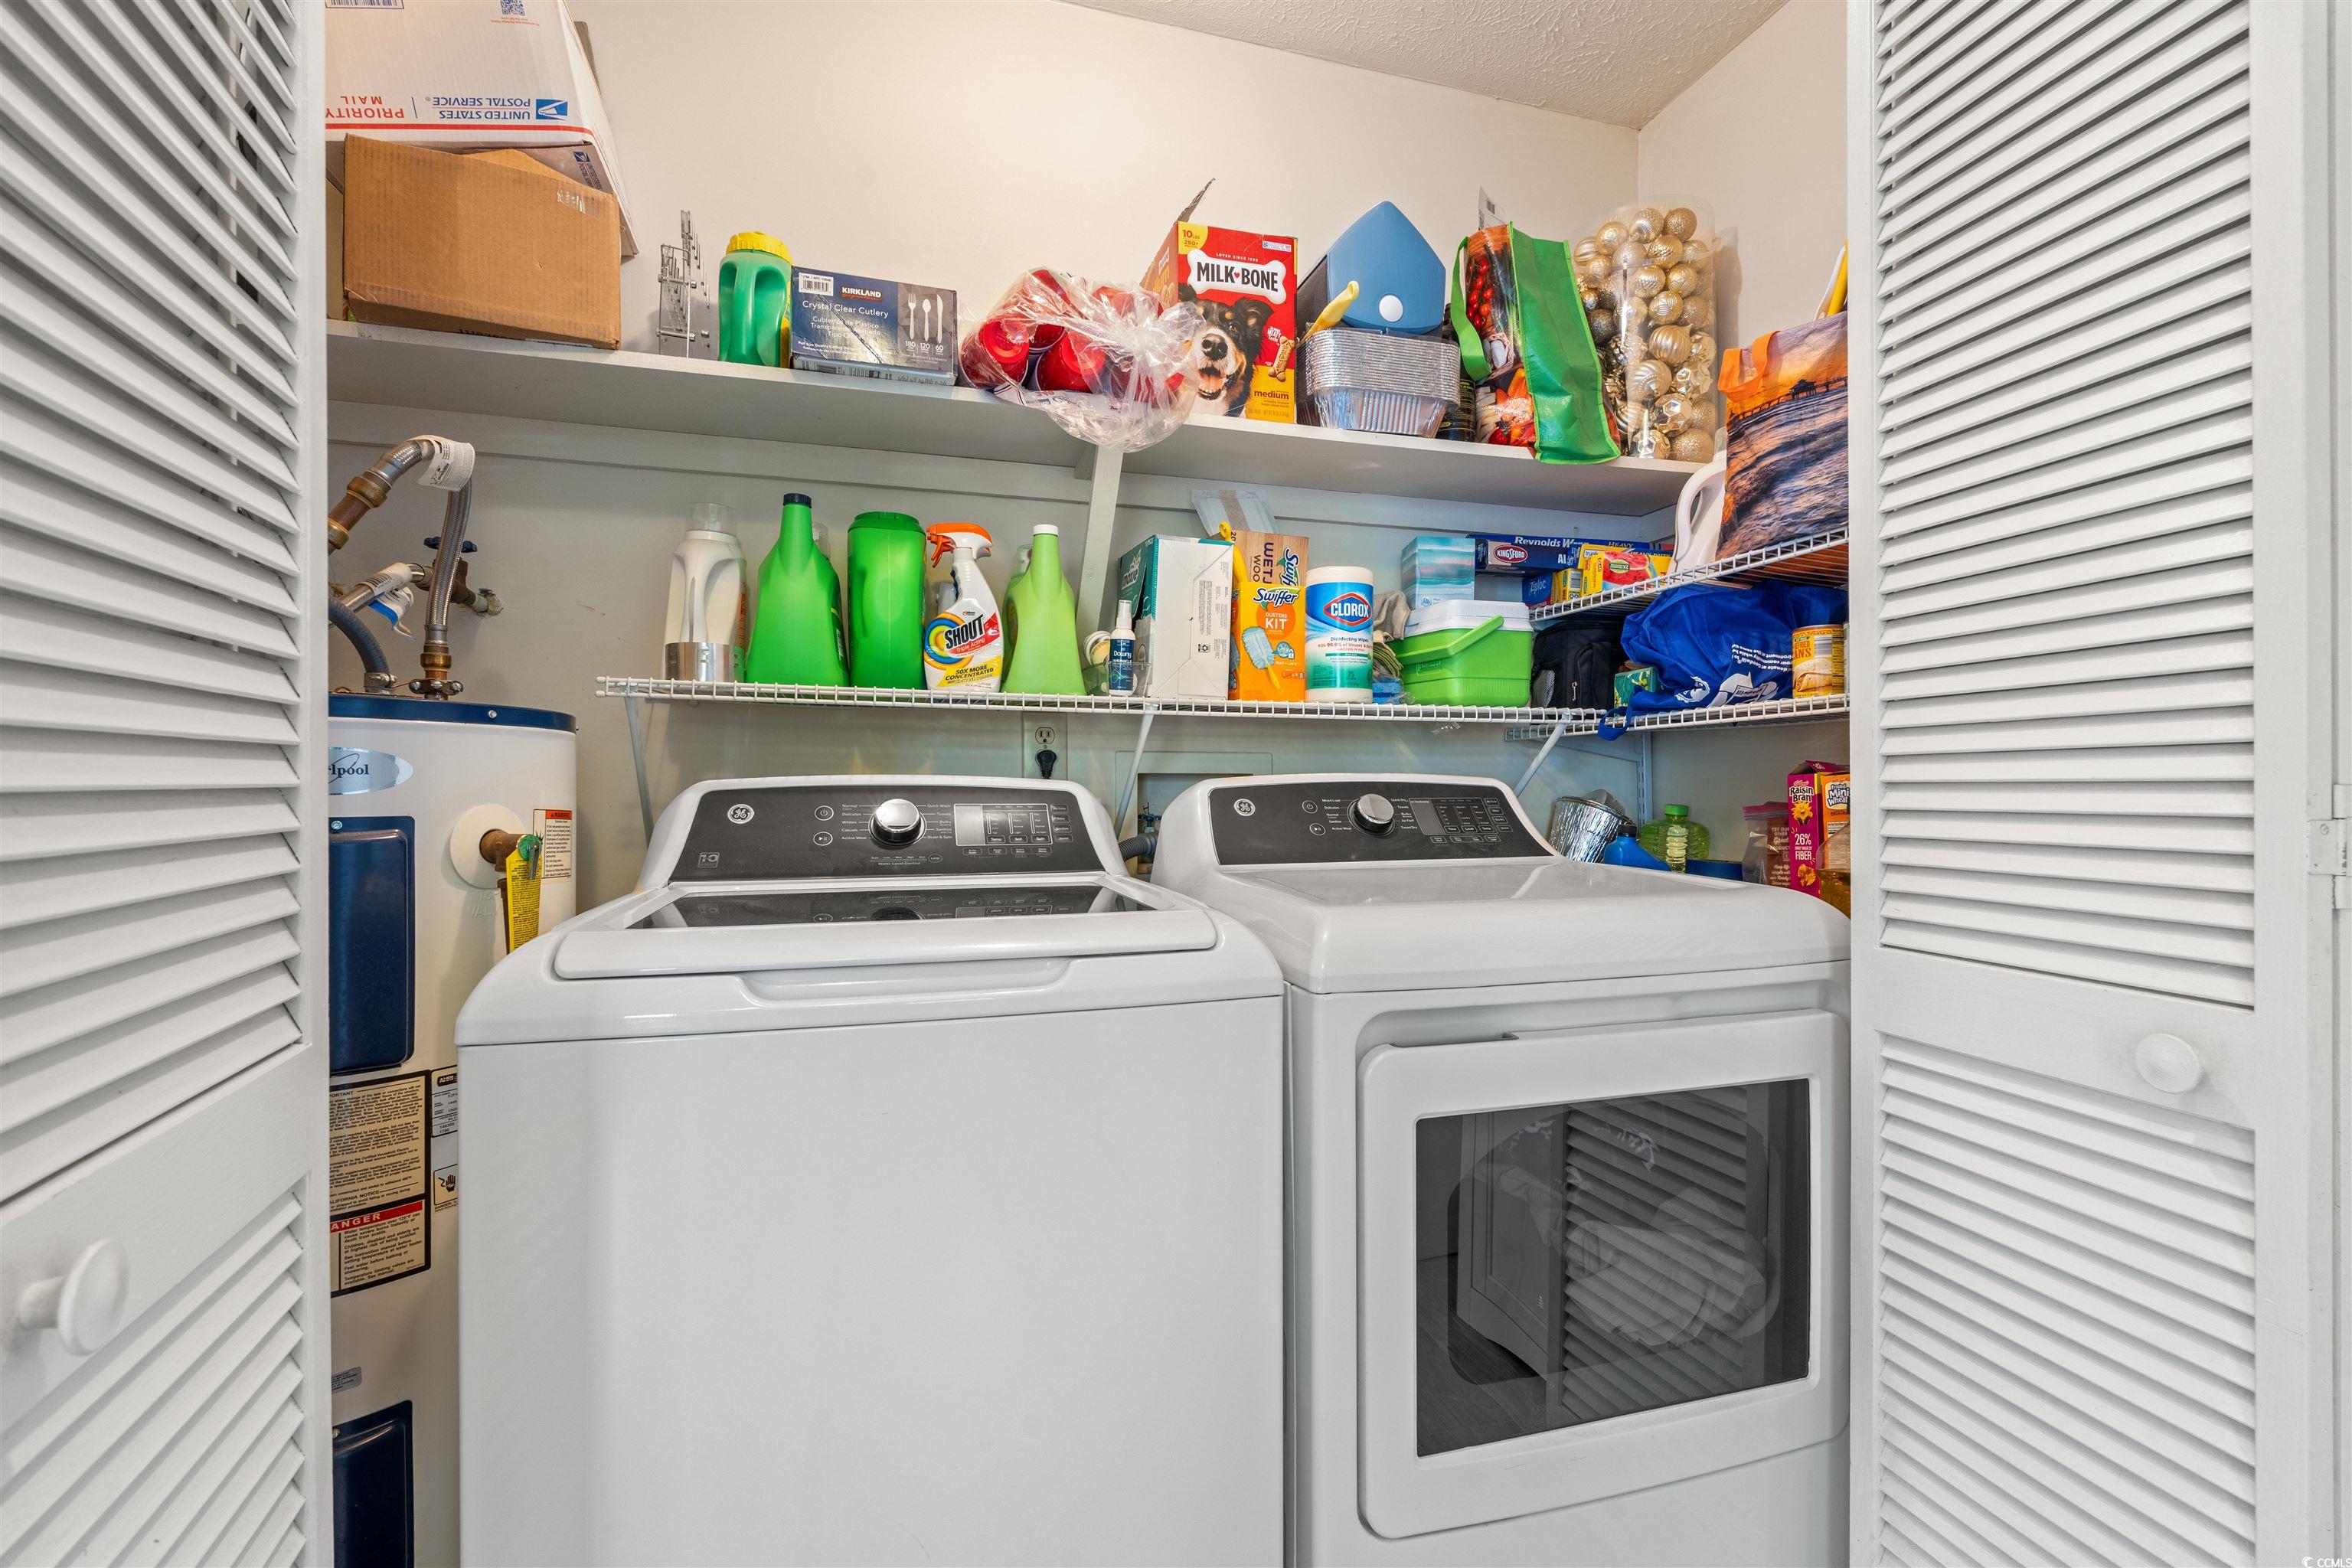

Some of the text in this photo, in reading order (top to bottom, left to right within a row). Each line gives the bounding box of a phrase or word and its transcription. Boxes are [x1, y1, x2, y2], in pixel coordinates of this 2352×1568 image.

[340, 96, 382, 105] MAIL
[433, 97, 530, 107] POSTAL SERVICE
[325, 107, 404, 119] PRIORITY
[439, 110, 530, 120] UNITED STATES
[1183, 230, 1193, 238] 10
[842, 287, 881, 298] KIRKLAND
[802, 300, 889, 318] Crystal Clear Cutlery
[1254, 390, 1289, 400] medium
[1230, 531, 1236, 541] 20
[1514, 536, 1561, 547] Reynolds
[1497, 548, 1525, 560] KINGSFORD
[1530, 580, 1546, 594] Ziploc
[1253, 588, 1297, 606] Swiffer
[1331, 603, 1369, 618] CLOROX
[1265, 618, 1287, 630] KIT
[944, 614, 984, 649] SHOUT
[970, 638, 985, 647] Acting
[1113, 650, 1132, 658] Downy
[1753, 654, 1780, 664] community
[945, 668, 994, 681] CONCENTRATED
[1790, 787, 1813, 795] Raisin
[1829, 788, 1849, 798] Mini
[1794, 833, 1811, 845] 26%
[1795, 851, 1812, 860] FIBER
[330, 1213, 381, 1231] ANGER
[359, 1222, 386, 1231] temperature
[355, 1248, 379, 1257] instruction
[362, 1250, 388, 1260] temperature
[344, 1266, 369, 1275] showering.
[344, 1271, 372, 1281] Temperature
